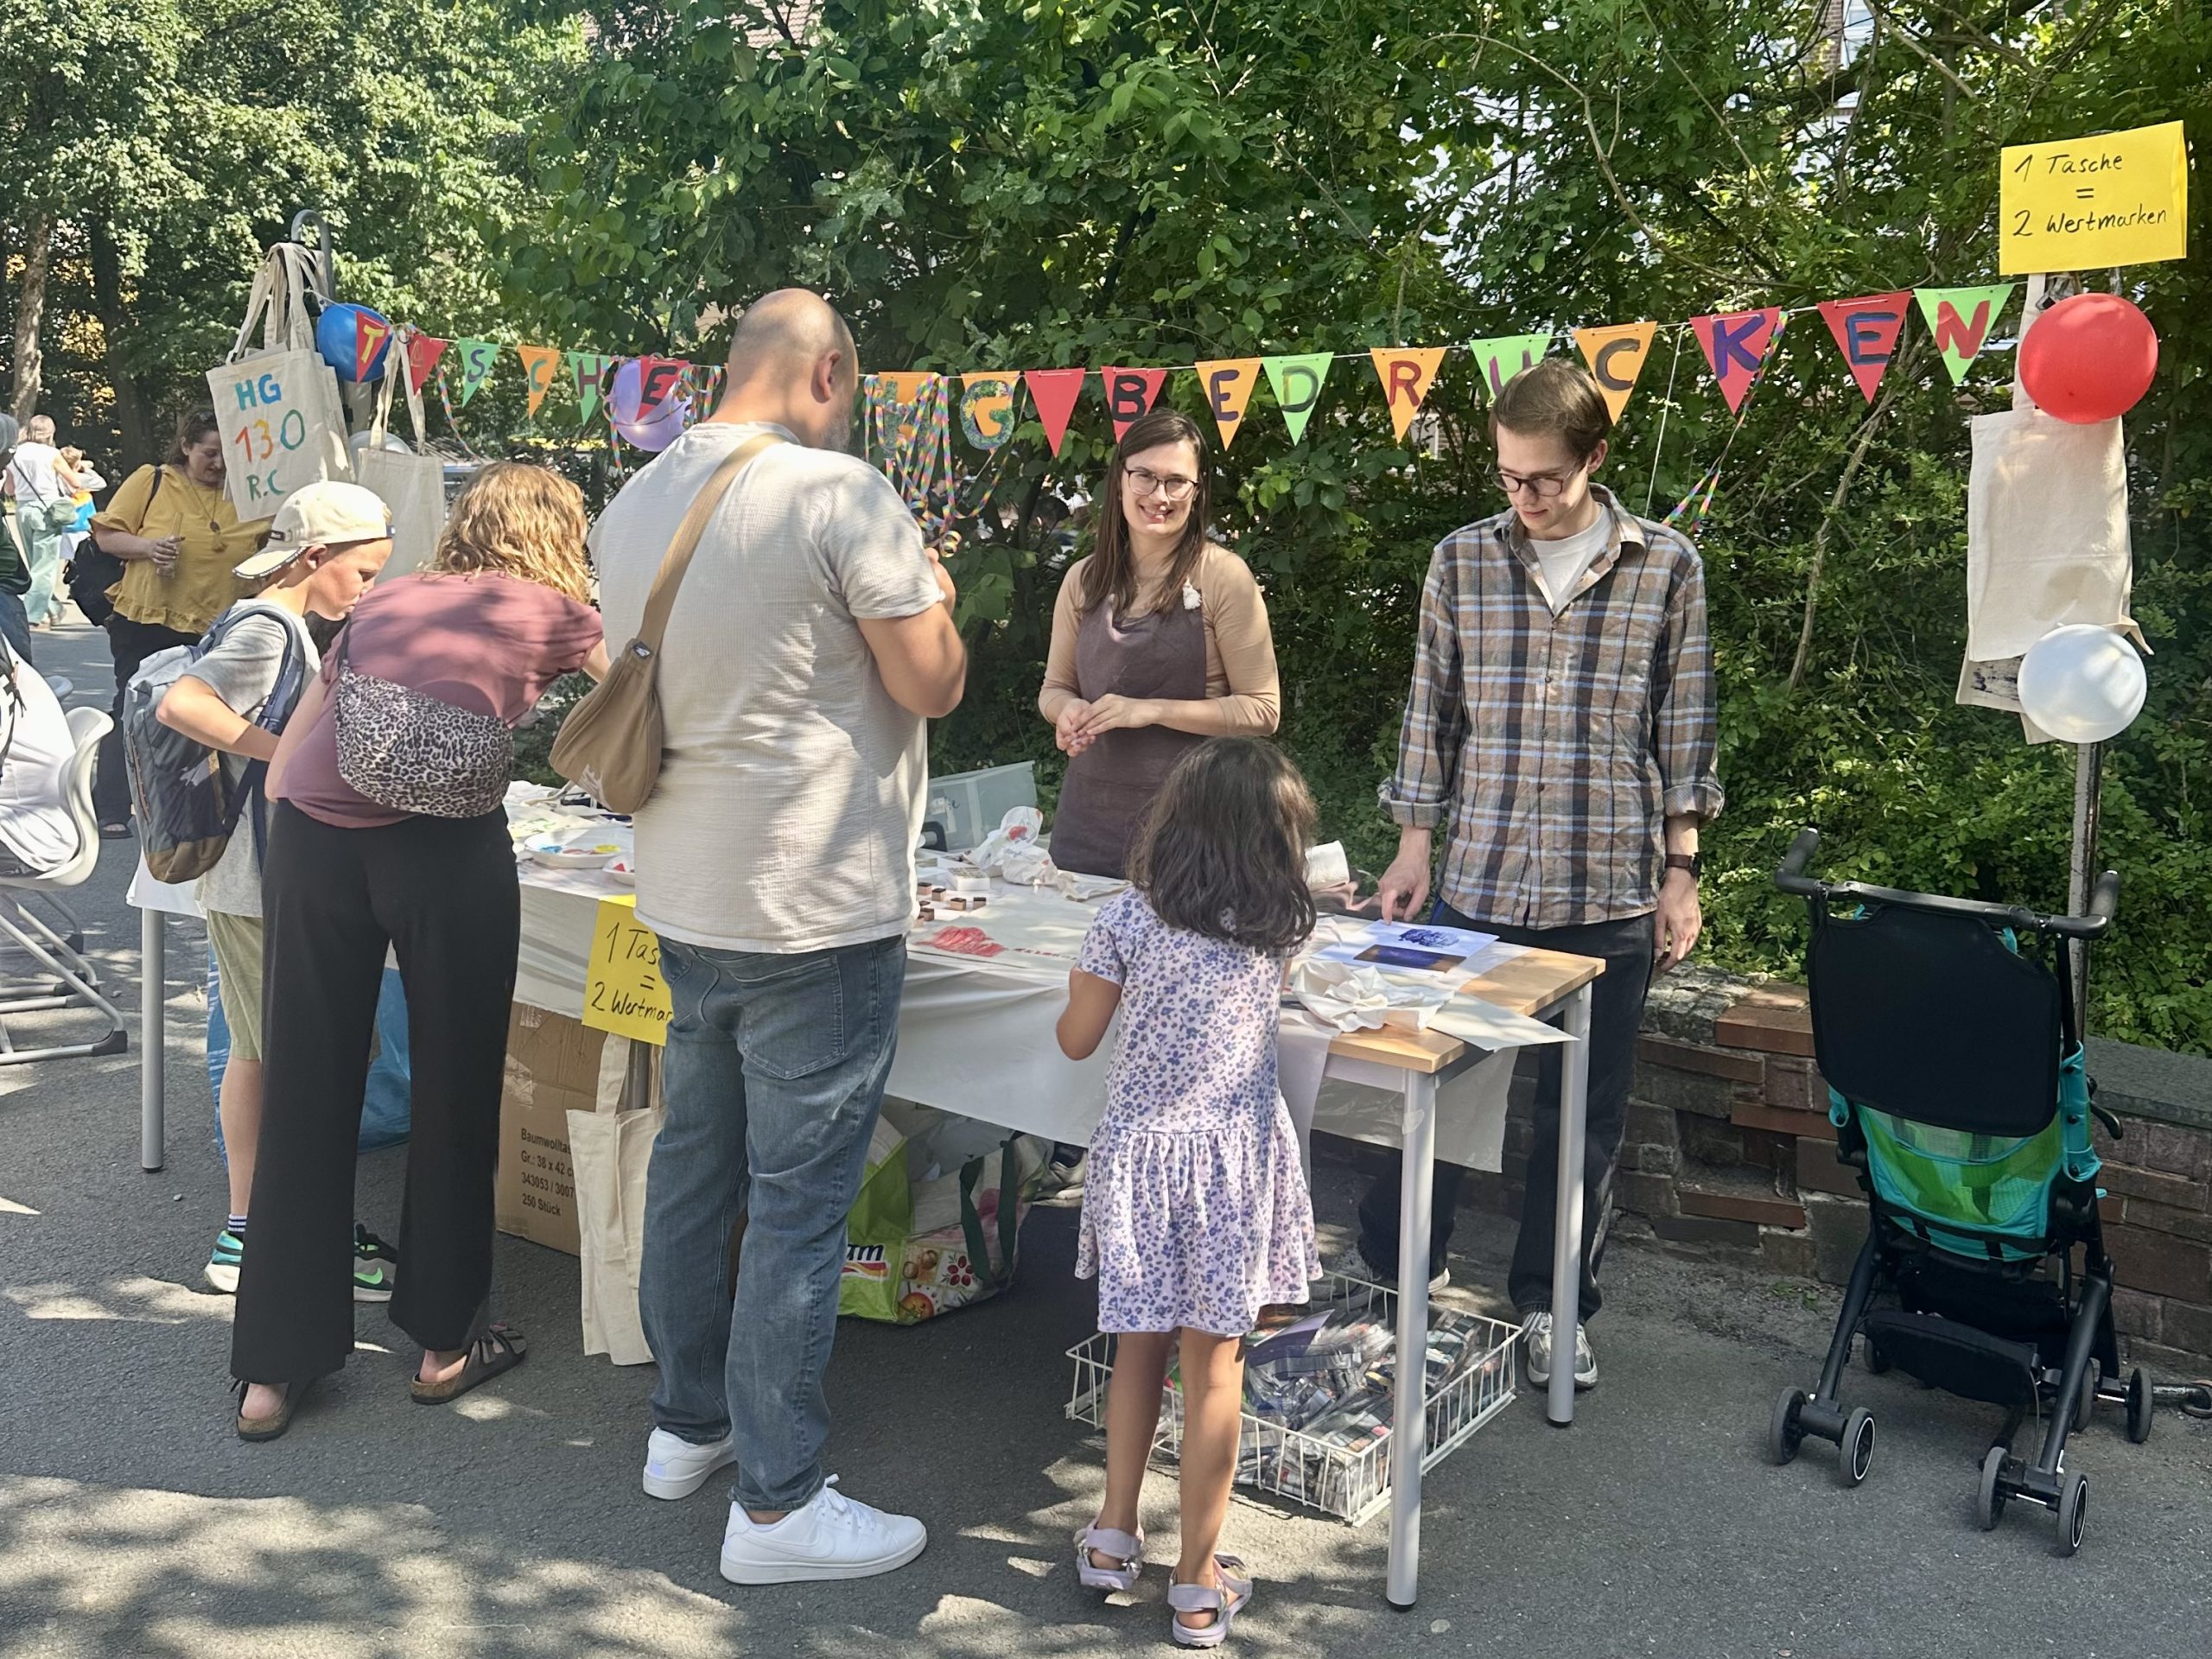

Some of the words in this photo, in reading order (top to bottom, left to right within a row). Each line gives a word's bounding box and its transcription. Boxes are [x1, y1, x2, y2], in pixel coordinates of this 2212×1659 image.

[2014, 154, 2033, 182] 1
[2046, 153, 2123, 175] Tasche
[2012, 210, 2032, 237] 2
[2046, 203, 2167, 233] Wertmarken
[234, 373, 282, 411] HG
[234, 409, 306, 464] 130
[607, 922, 620, 963] 1
[628, 928, 662, 966] Tas
[591, 982, 606, 1012] 2
[611, 989, 673, 1022] Wertmar
[521, 1128, 571, 1154] Baumwolltas
[537, 1154, 547, 1169] 38
[548, 1160, 554, 1172] x
[555, 1160, 566, 1176] 42
[567, 1166, 575, 1178] c
[521, 1172, 550, 1192] 343053
[522, 1192, 537, 1209] 250
[537, 1198, 562, 1217] Stück
